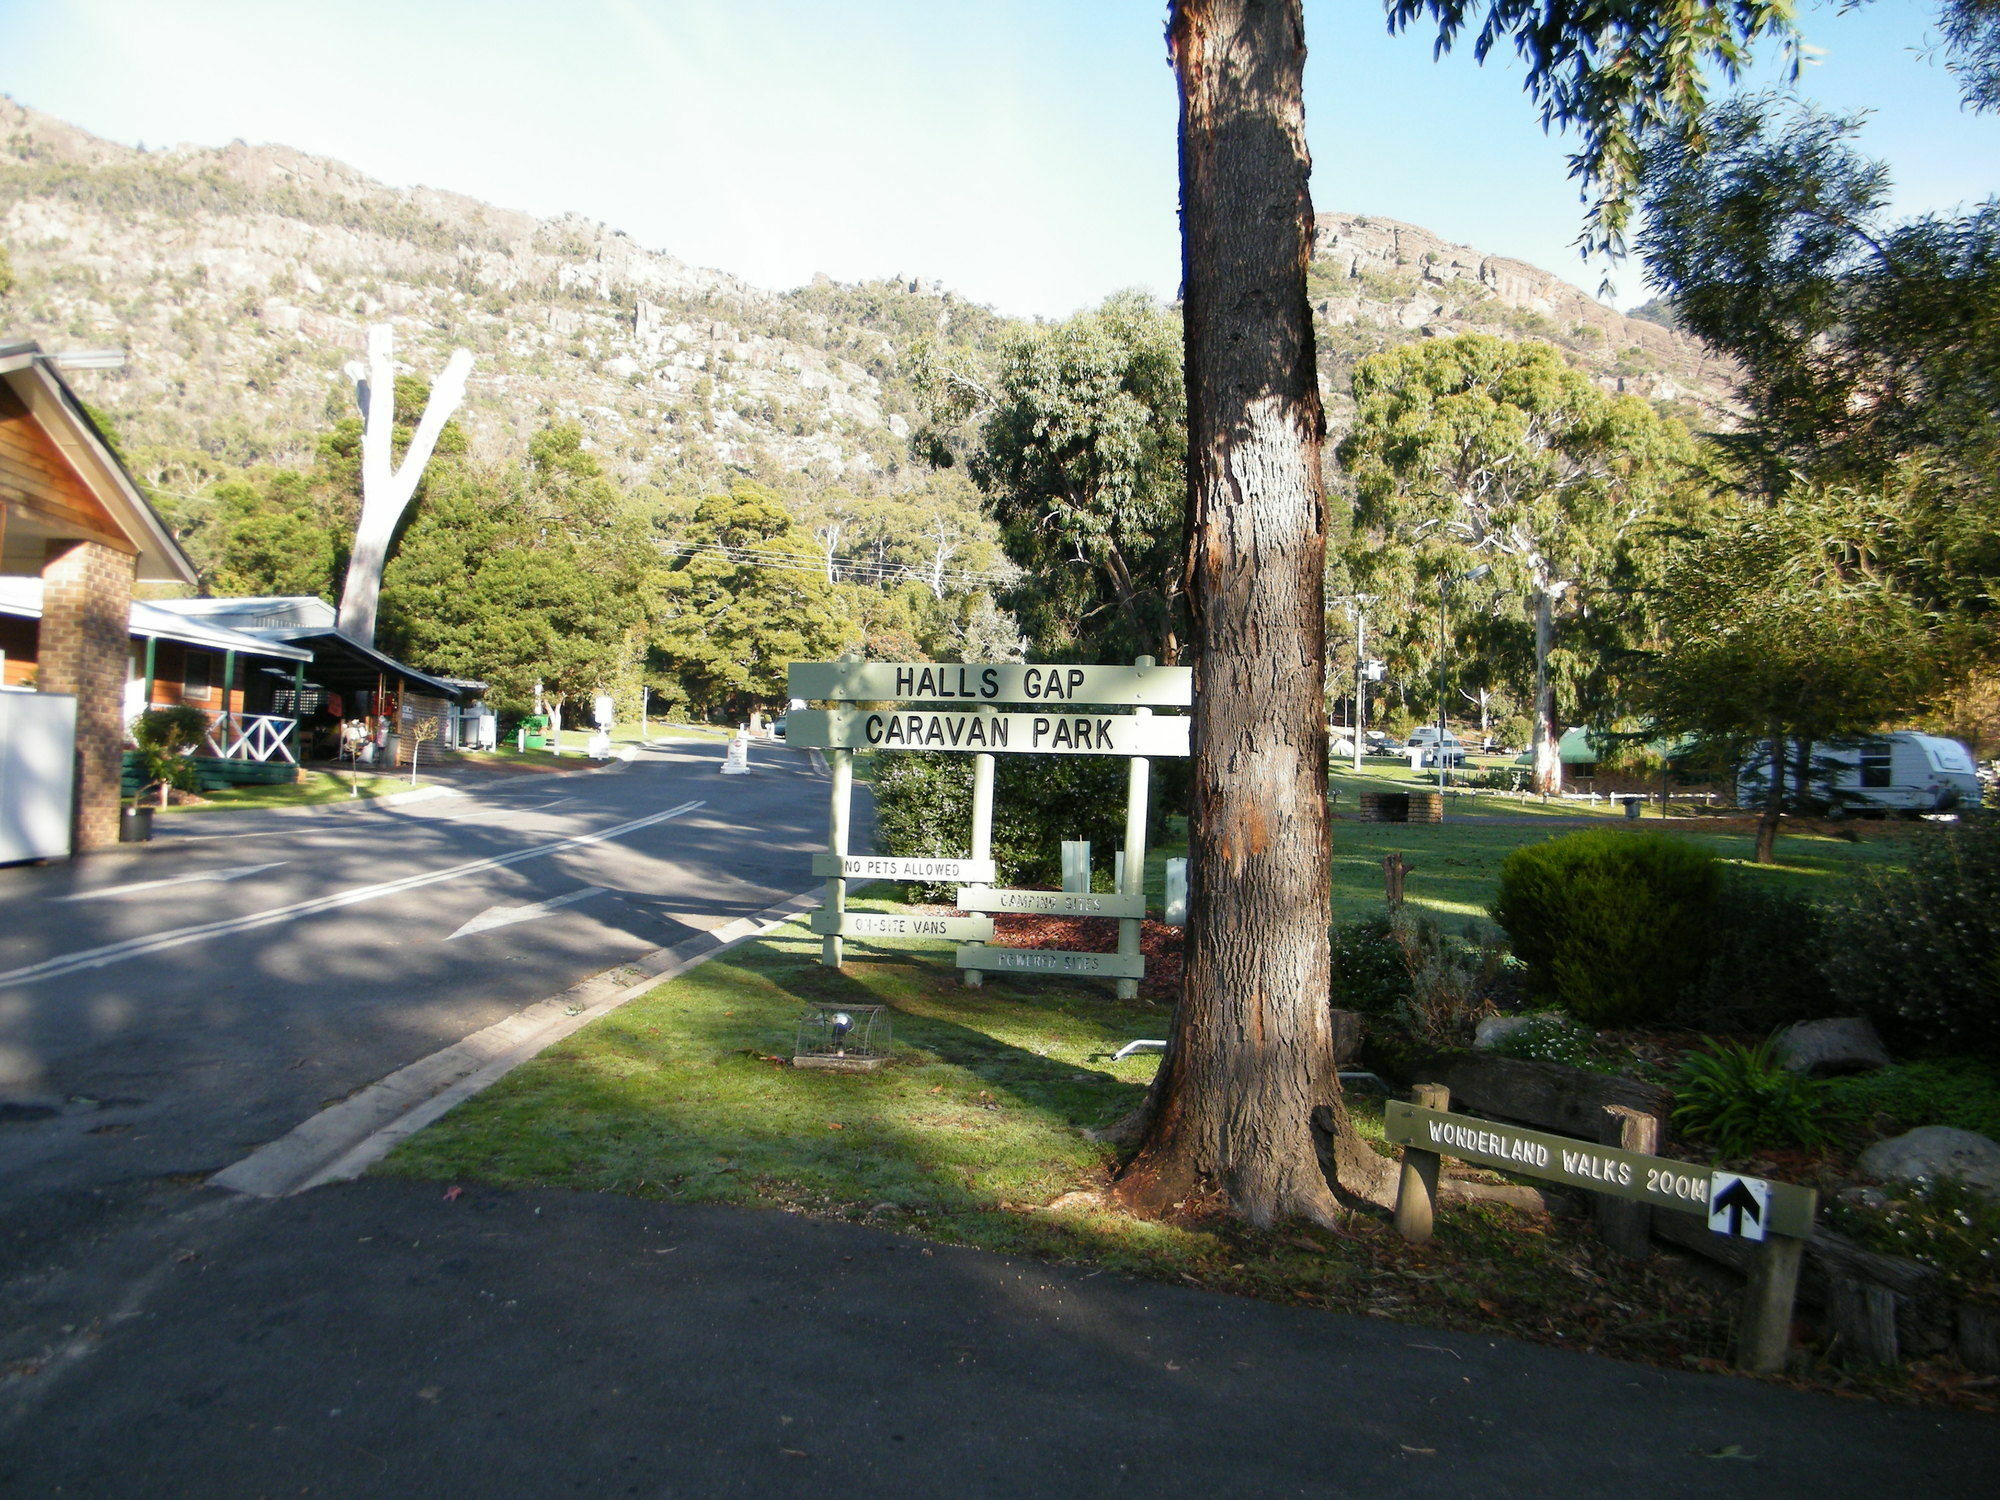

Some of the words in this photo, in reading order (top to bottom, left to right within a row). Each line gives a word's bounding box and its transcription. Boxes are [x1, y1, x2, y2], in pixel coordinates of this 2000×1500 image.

[896, 667, 999, 699] HALLS
[1024, 668, 1085, 700] GAP
[865, 714, 1009, 748] CARAVAN
[1032, 717, 1114, 750] PARK
[844, 860, 861, 873] NO
[867, 860, 897, 875] PETS
[903, 862, 960, 877] ALLOWED
[1000, 893, 1056, 910] CAMPING
[1064, 896, 1101, 912] SITES
[855, 918, 906, 933] ON-SITE
[913, 919, 947, 934] VANS
[998, 952, 1056, 969] POWERED
[1063, 955, 1099, 971] SITES
[1428, 1119, 1548, 1168] WONDERLAND
[1561, 1148, 1631, 1187] WALKS
[1646, 1167, 1711, 1204] 200M
